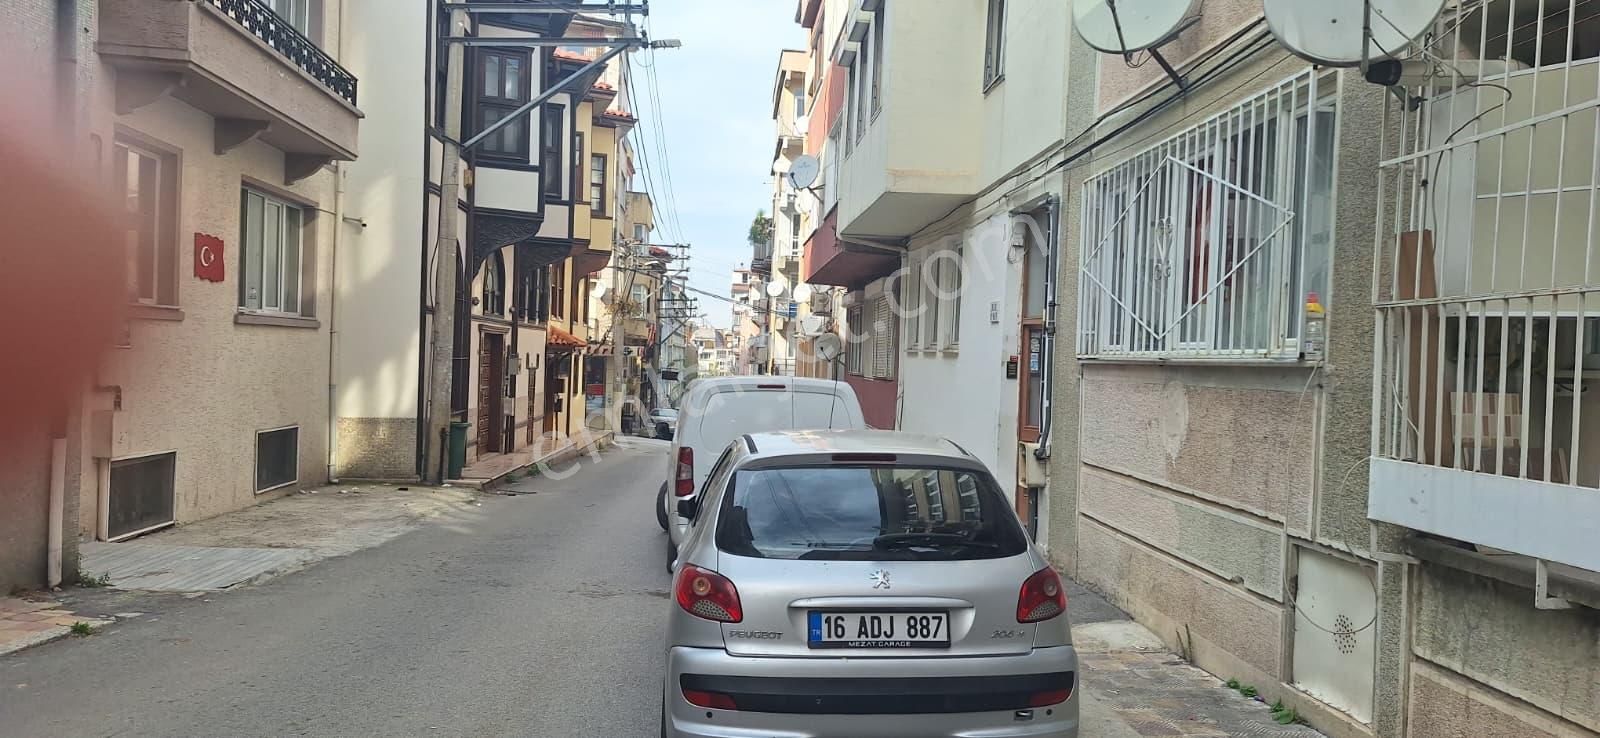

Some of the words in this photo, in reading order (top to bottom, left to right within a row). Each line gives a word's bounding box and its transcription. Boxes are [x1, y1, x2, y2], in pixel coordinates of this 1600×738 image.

[729, 629, 785, 640] PEUGEOT
[824, 615, 846, 639] 16
[857, 615, 894, 639] ADJ
[906, 615, 943, 639] 887
